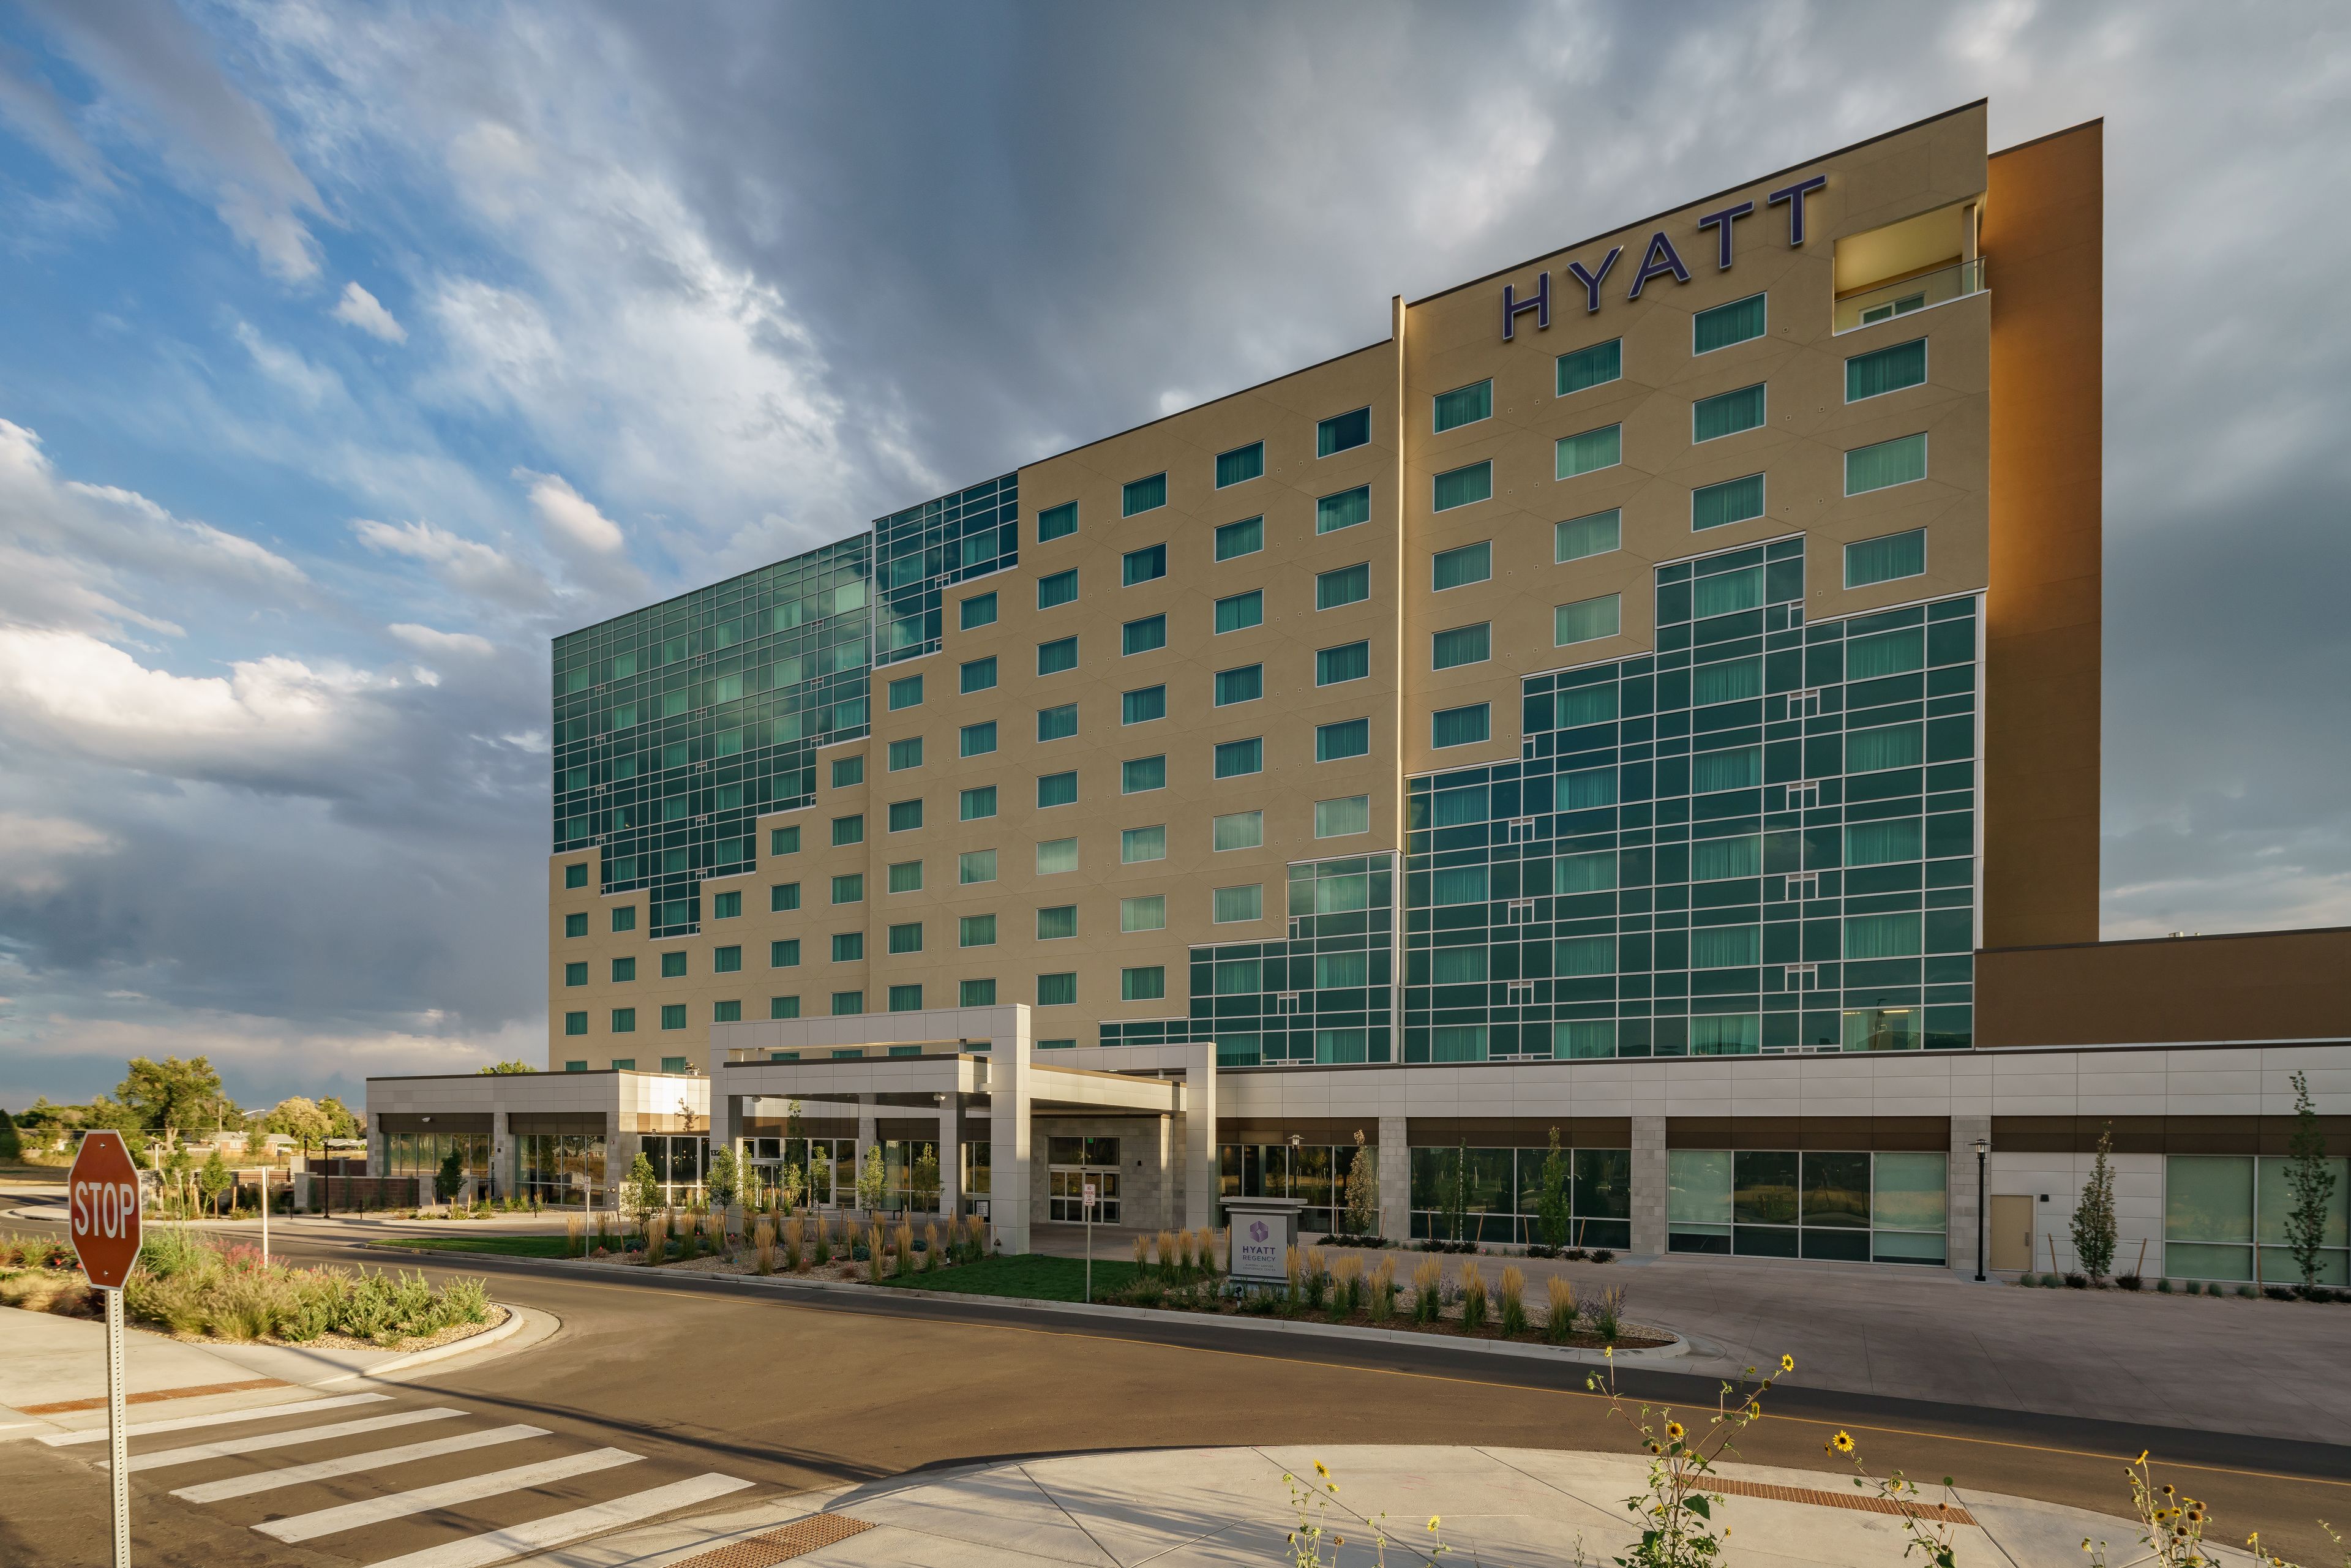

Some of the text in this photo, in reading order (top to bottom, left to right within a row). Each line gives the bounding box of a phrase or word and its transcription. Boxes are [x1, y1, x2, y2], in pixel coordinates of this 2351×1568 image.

[1502, 174, 1827, 341] HYATT
[75, 1181, 135, 1238] STOP
[1243, 1245, 1275, 1255] HYATT
